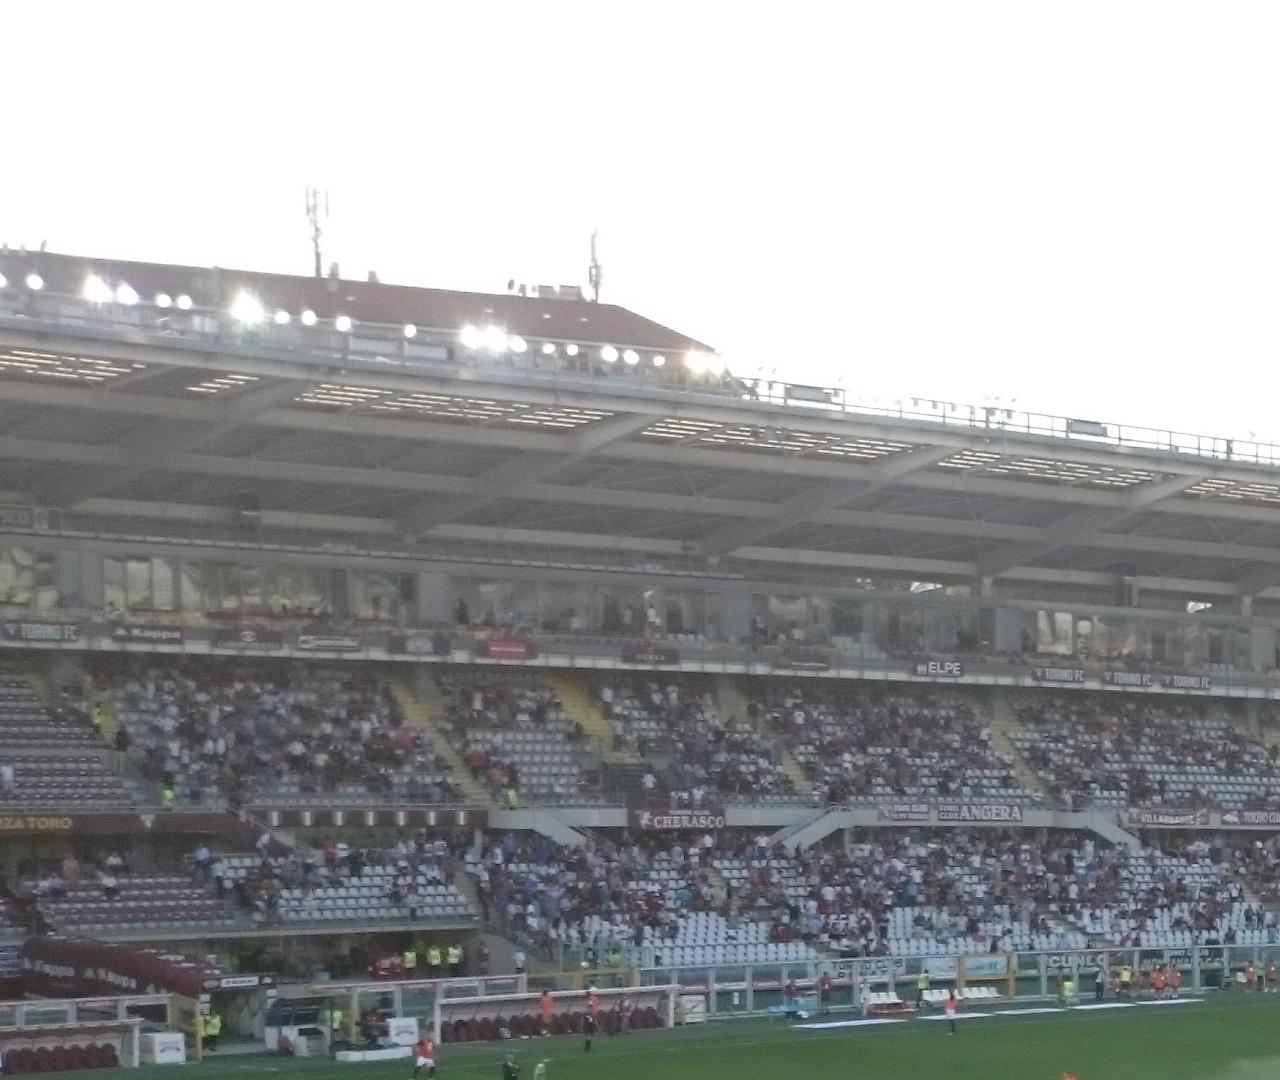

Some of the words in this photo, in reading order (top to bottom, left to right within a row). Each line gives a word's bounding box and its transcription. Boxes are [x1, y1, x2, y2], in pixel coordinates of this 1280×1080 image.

[131, 627, 181, 639] Kappa
[929, 662, 961, 675] ELPE
[959, 805, 1022, 821] ANGERA
[28, 816, 72, 830] TORO
[655, 816, 724, 829] CHERASCO
